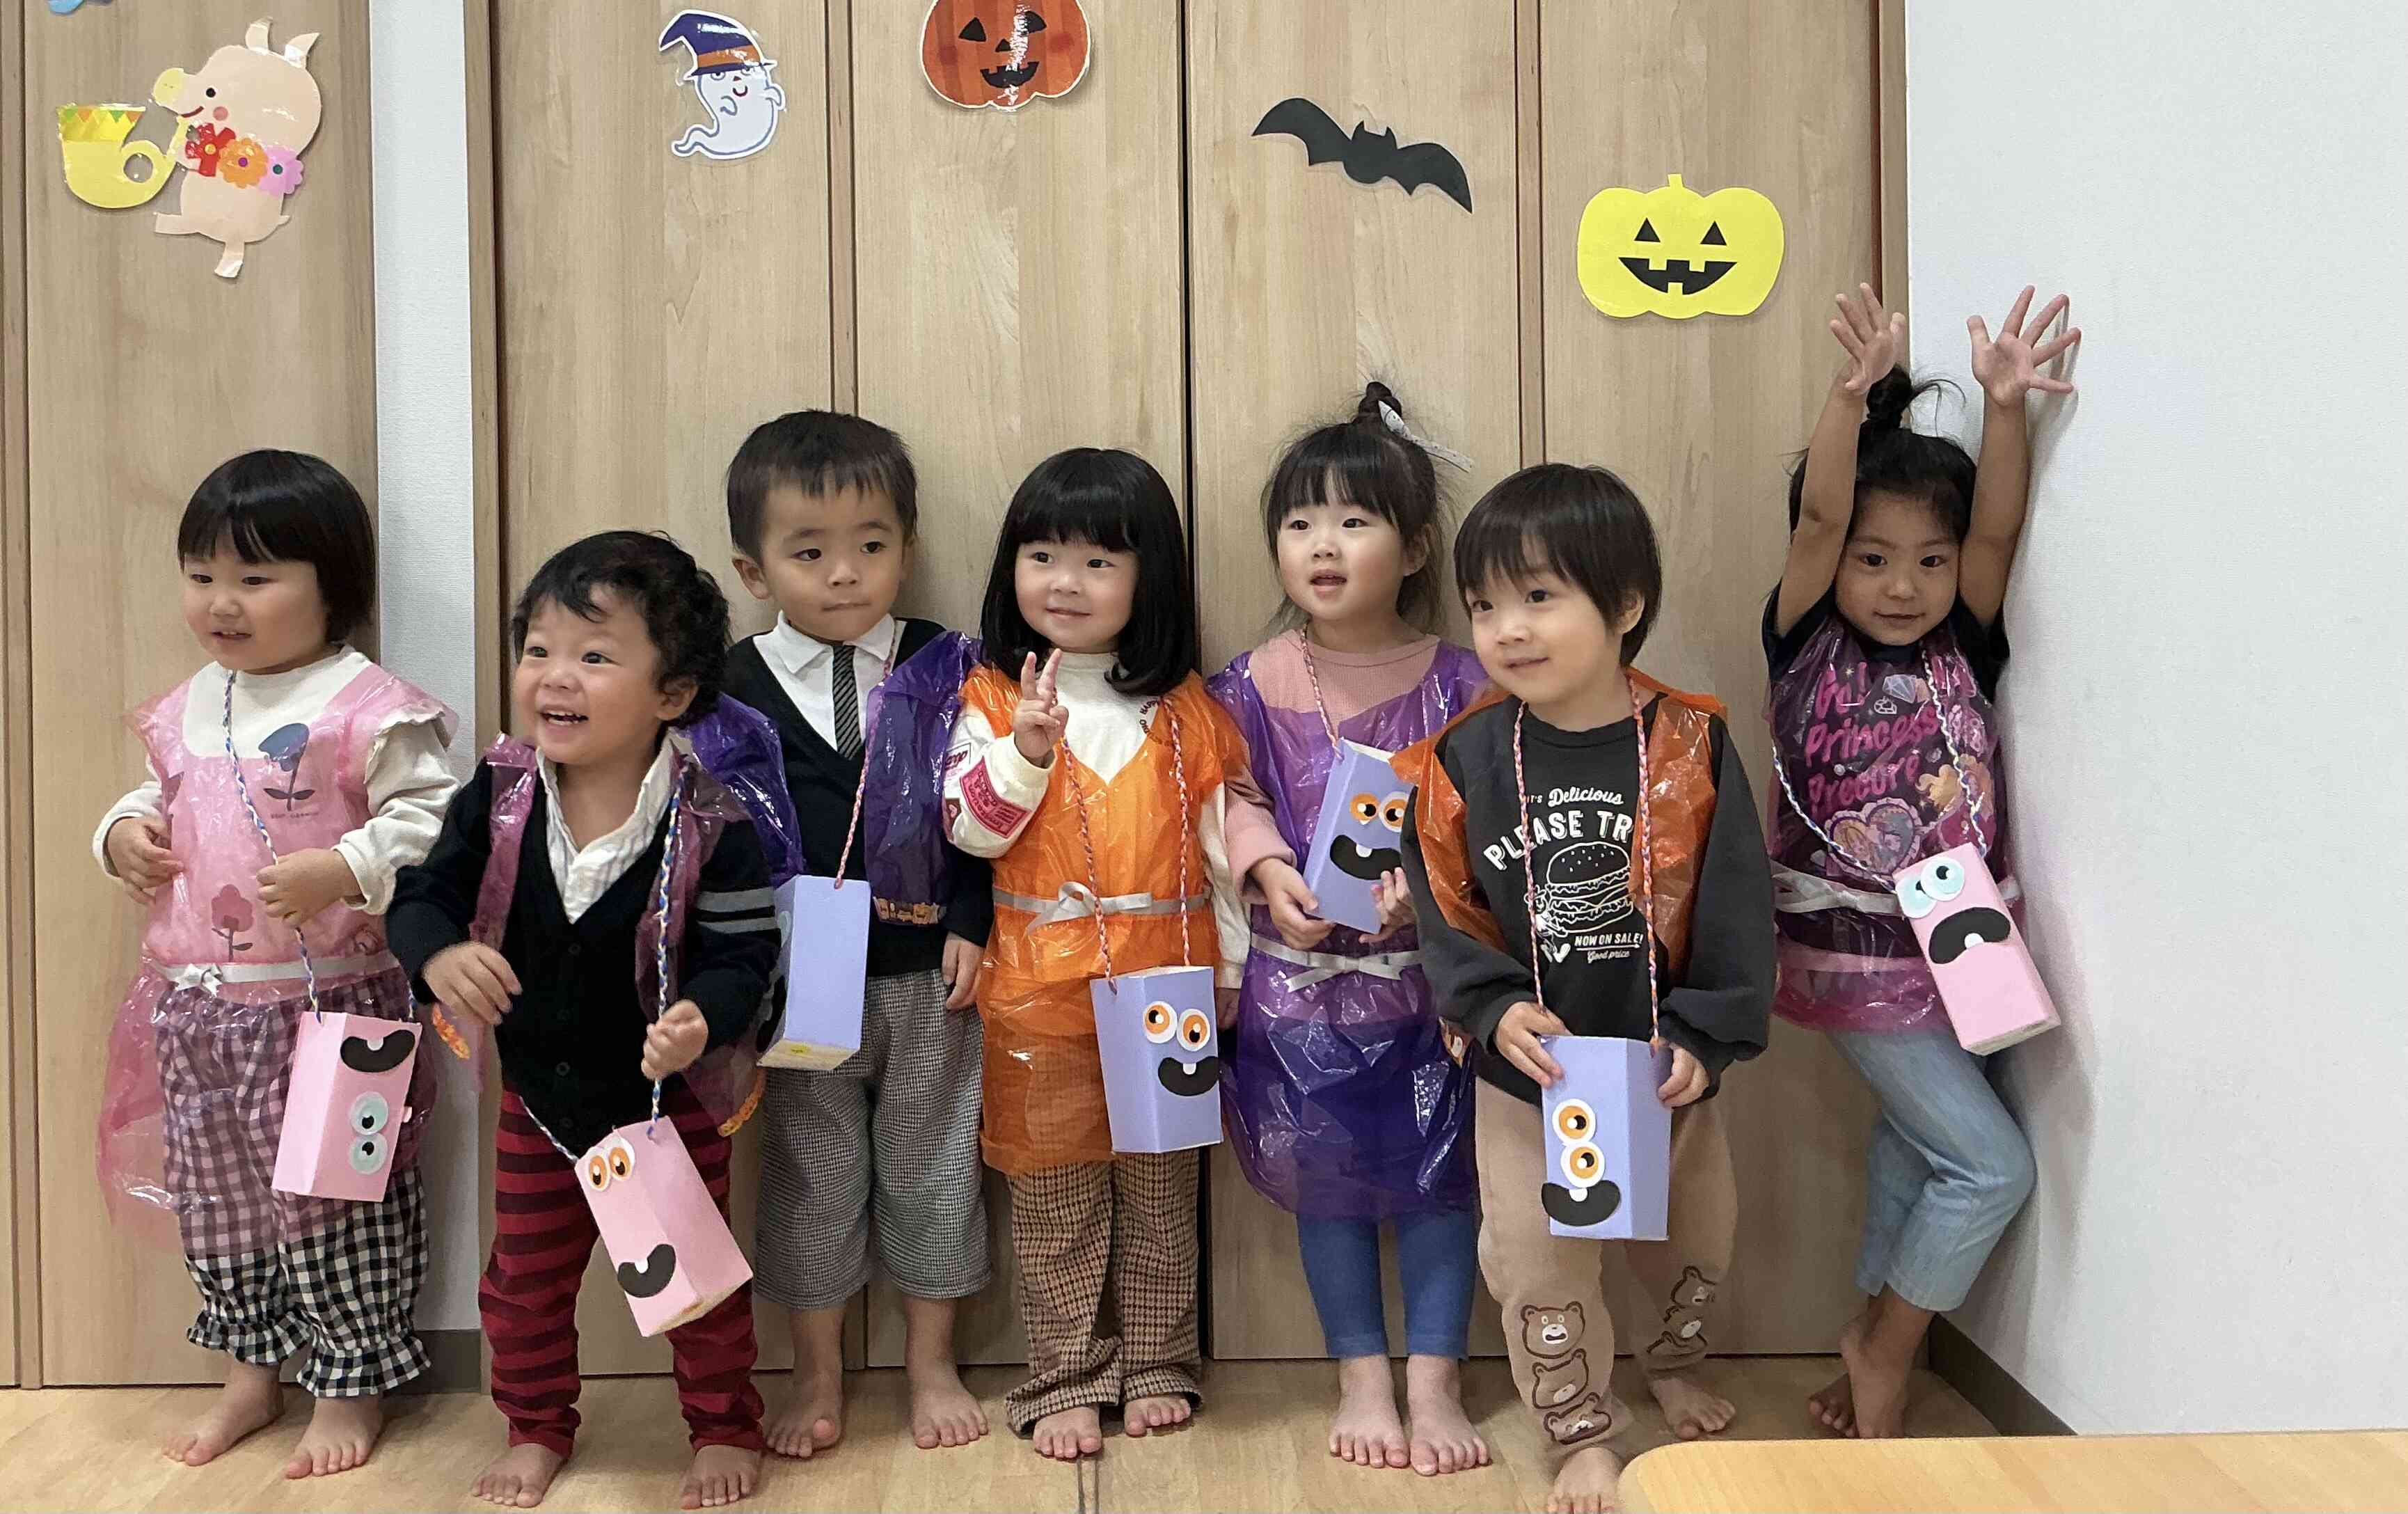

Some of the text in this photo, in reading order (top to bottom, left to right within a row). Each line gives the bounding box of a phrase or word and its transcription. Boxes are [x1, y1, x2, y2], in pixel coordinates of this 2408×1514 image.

[1547, 786, 1624, 807] Delicious
[1483, 810, 1634, 870] PLEASE TR
[1574, 932, 1644, 947] NOW ON SALE!
